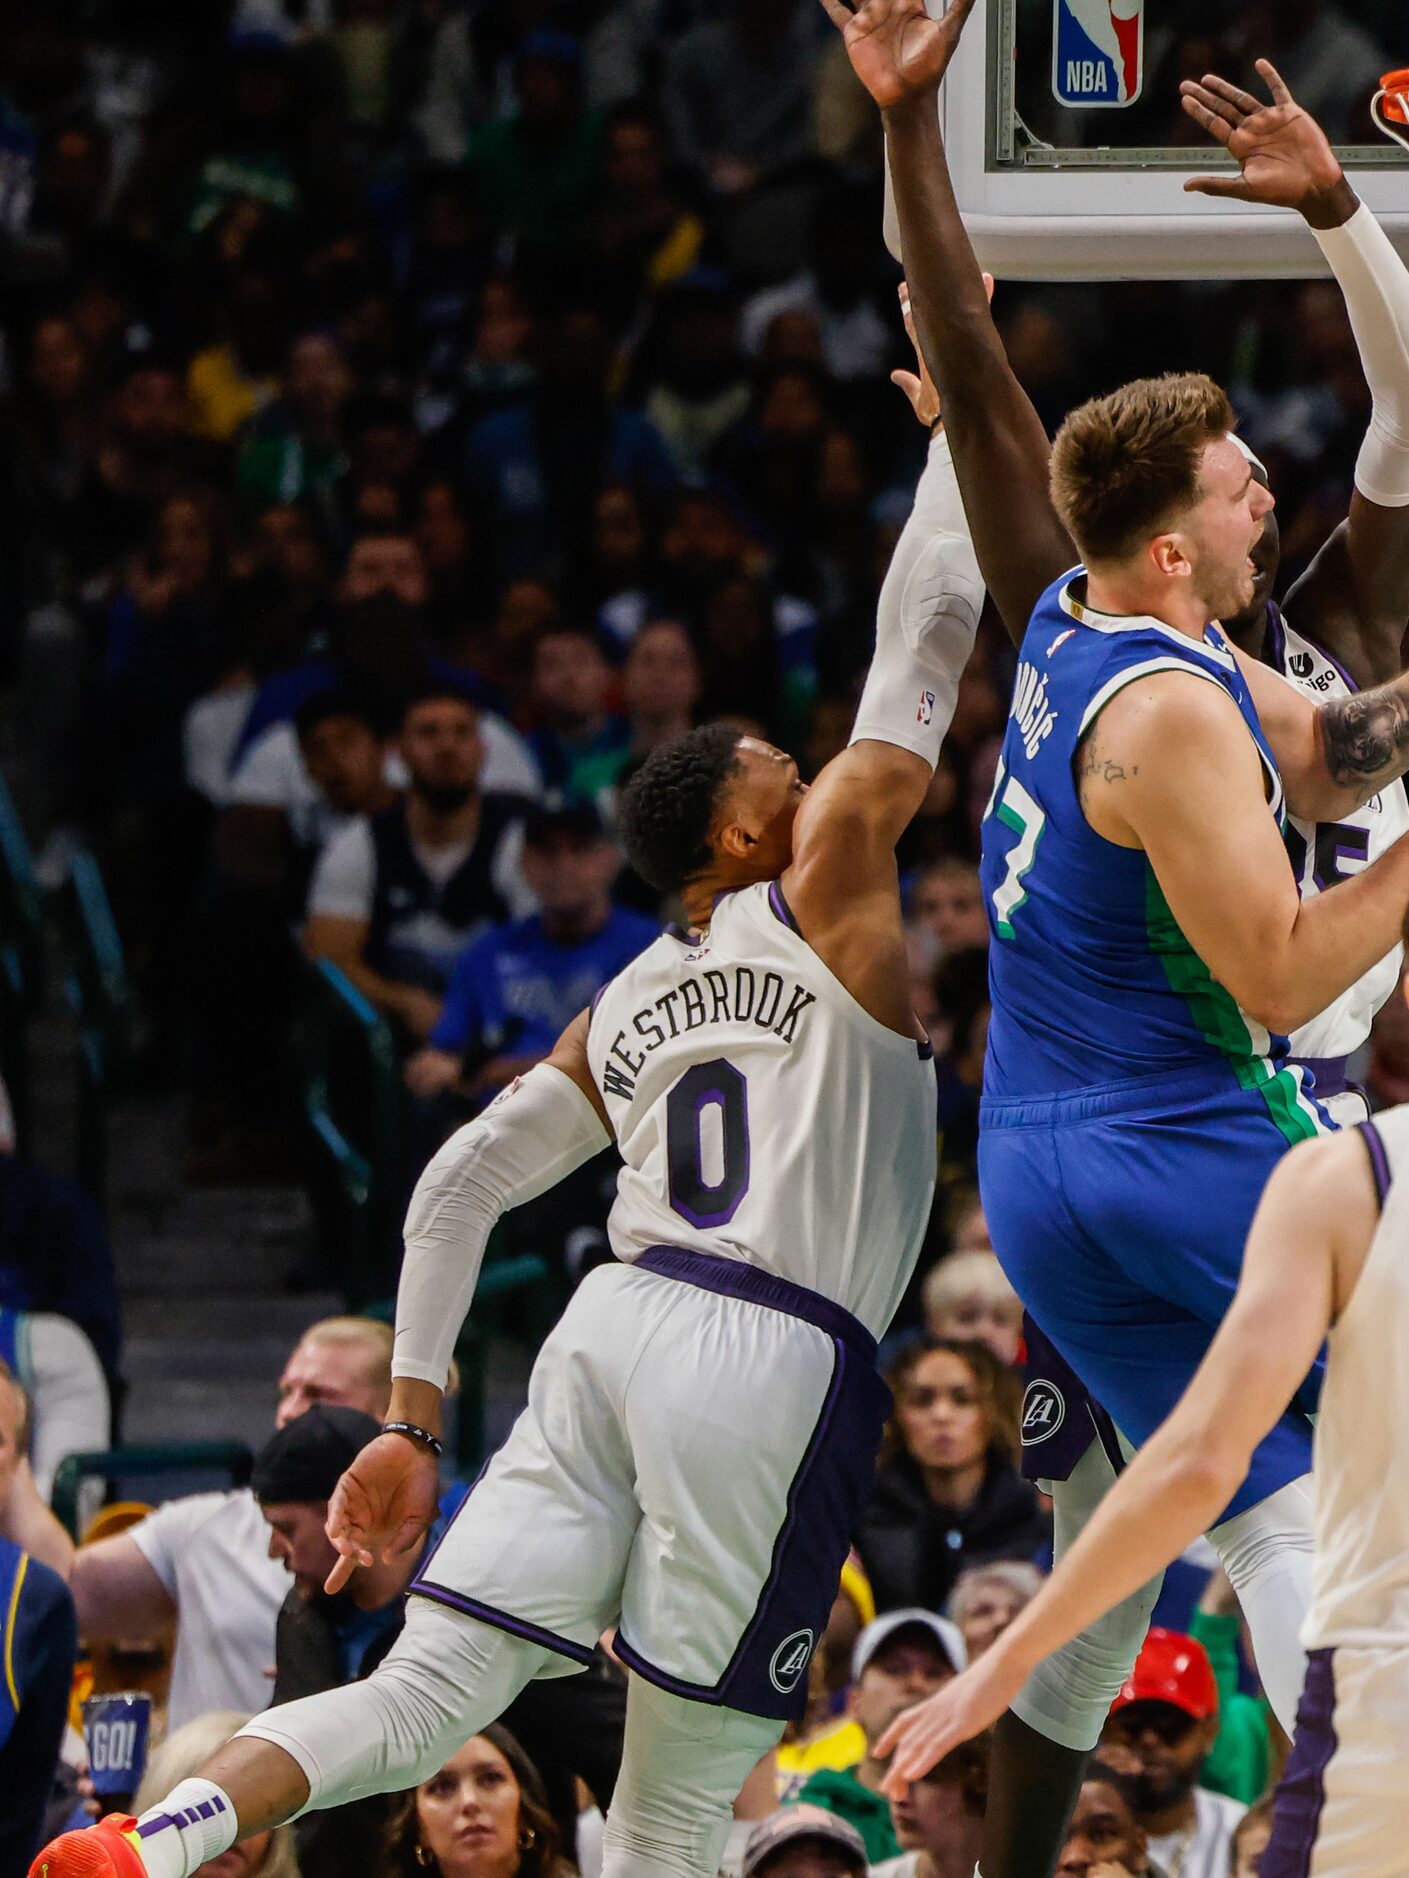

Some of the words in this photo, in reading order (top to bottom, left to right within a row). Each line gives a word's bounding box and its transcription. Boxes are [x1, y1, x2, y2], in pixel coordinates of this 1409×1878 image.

[1066, 60, 1107, 93] NBA
[1297, 670, 1336, 691] igo
[604, 967, 816, 1101] WESTBROOK
[667, 1058, 750, 1229] 0
[93, 1721, 137, 1771] GO!
